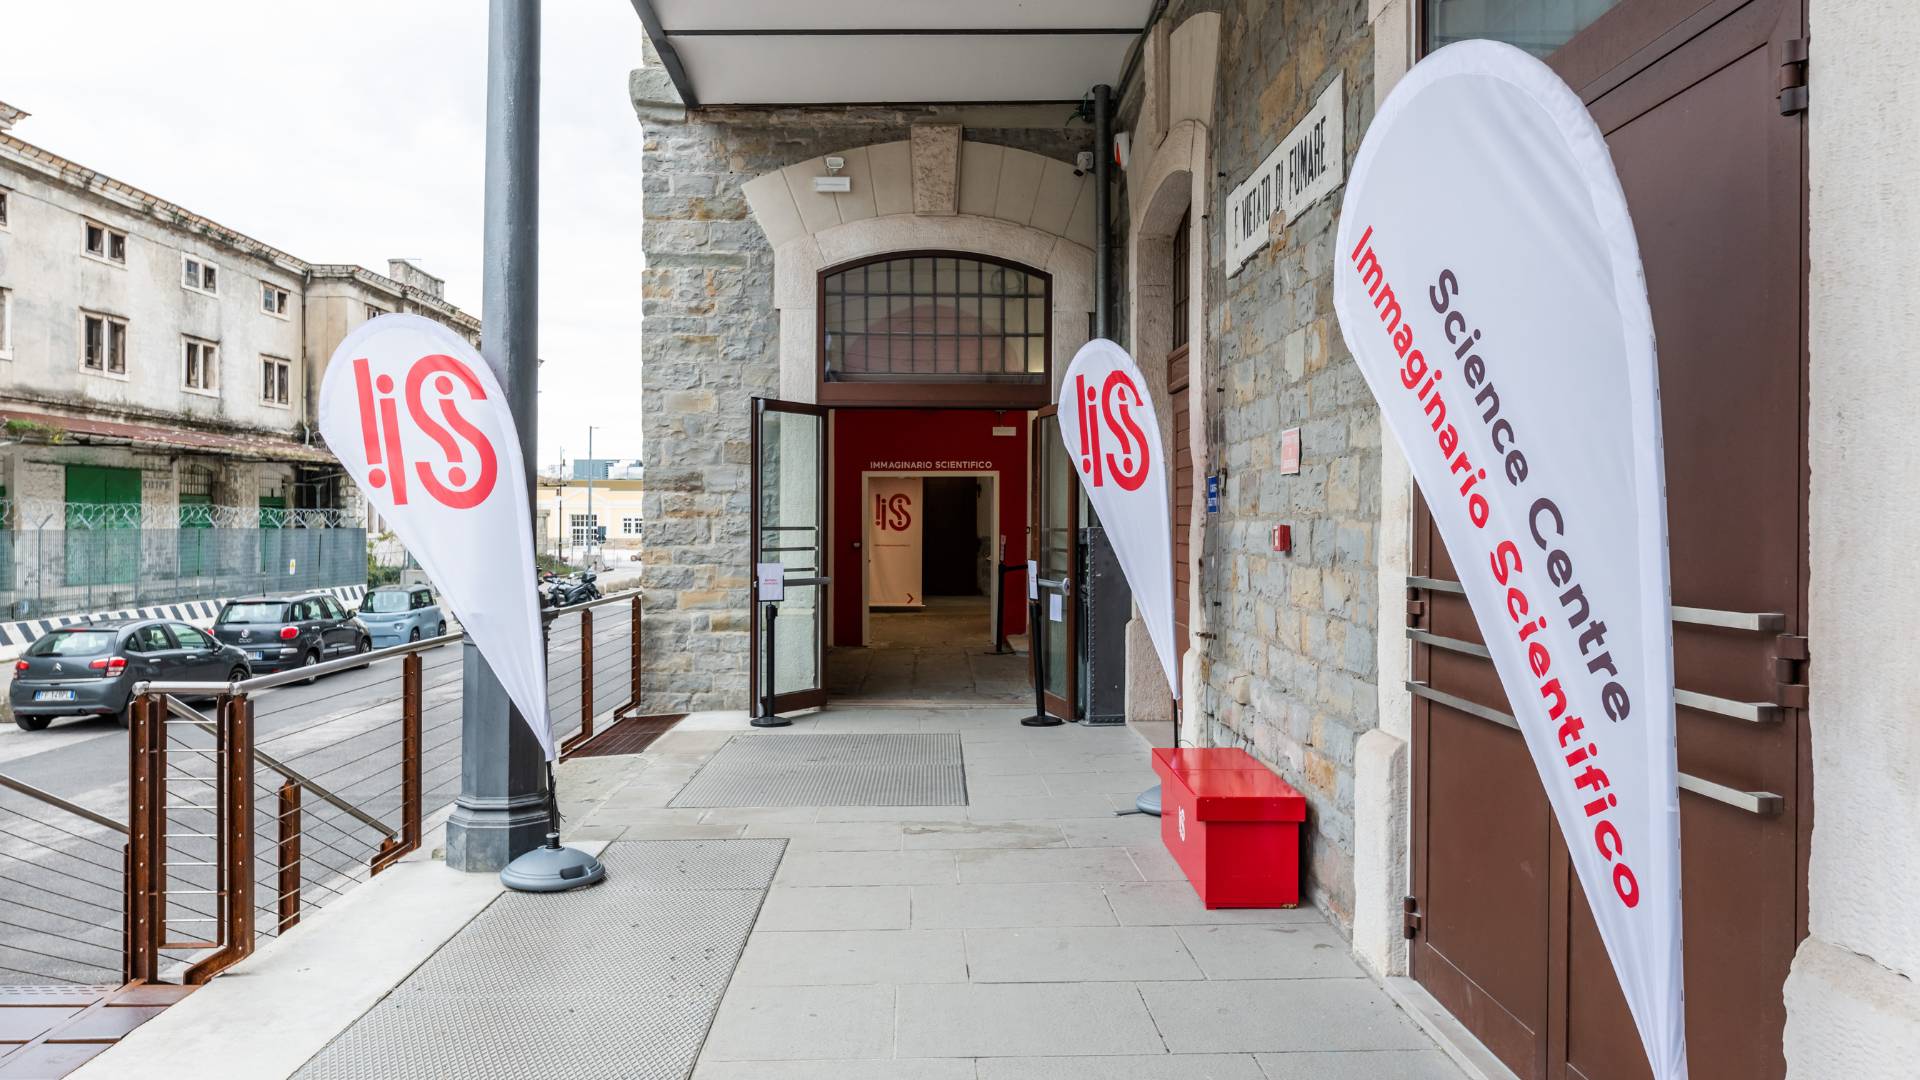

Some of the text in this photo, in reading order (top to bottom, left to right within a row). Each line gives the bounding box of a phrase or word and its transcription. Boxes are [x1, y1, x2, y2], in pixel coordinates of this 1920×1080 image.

[1242, 174, 1271, 241] VIETATO
[1275, 160, 1284, 213] DI
[1289, 115, 1326, 201] FUMARE
[870, 460, 993, 469] IMMAGINARIO SCIENTIFICO
[1351, 224, 1640, 909] Immaginario Scientifico
[1429, 268, 1631, 723] Science Centre
